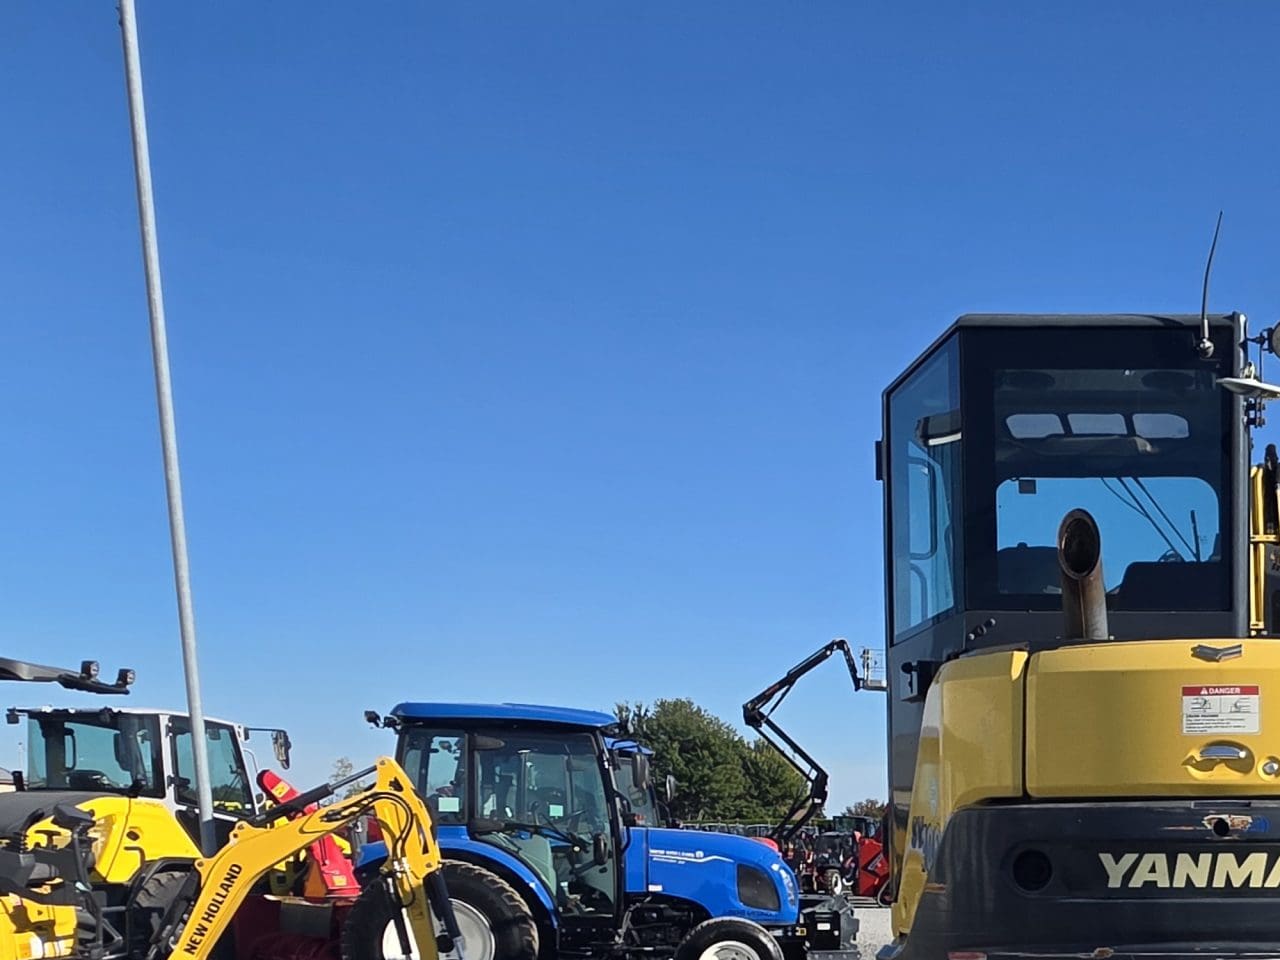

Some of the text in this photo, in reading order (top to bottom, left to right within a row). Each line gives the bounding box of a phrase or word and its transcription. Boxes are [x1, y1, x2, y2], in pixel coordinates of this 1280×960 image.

[1208, 687, 1241, 695] DANGER
[183, 863, 243, 955] NEW HOLLAND
